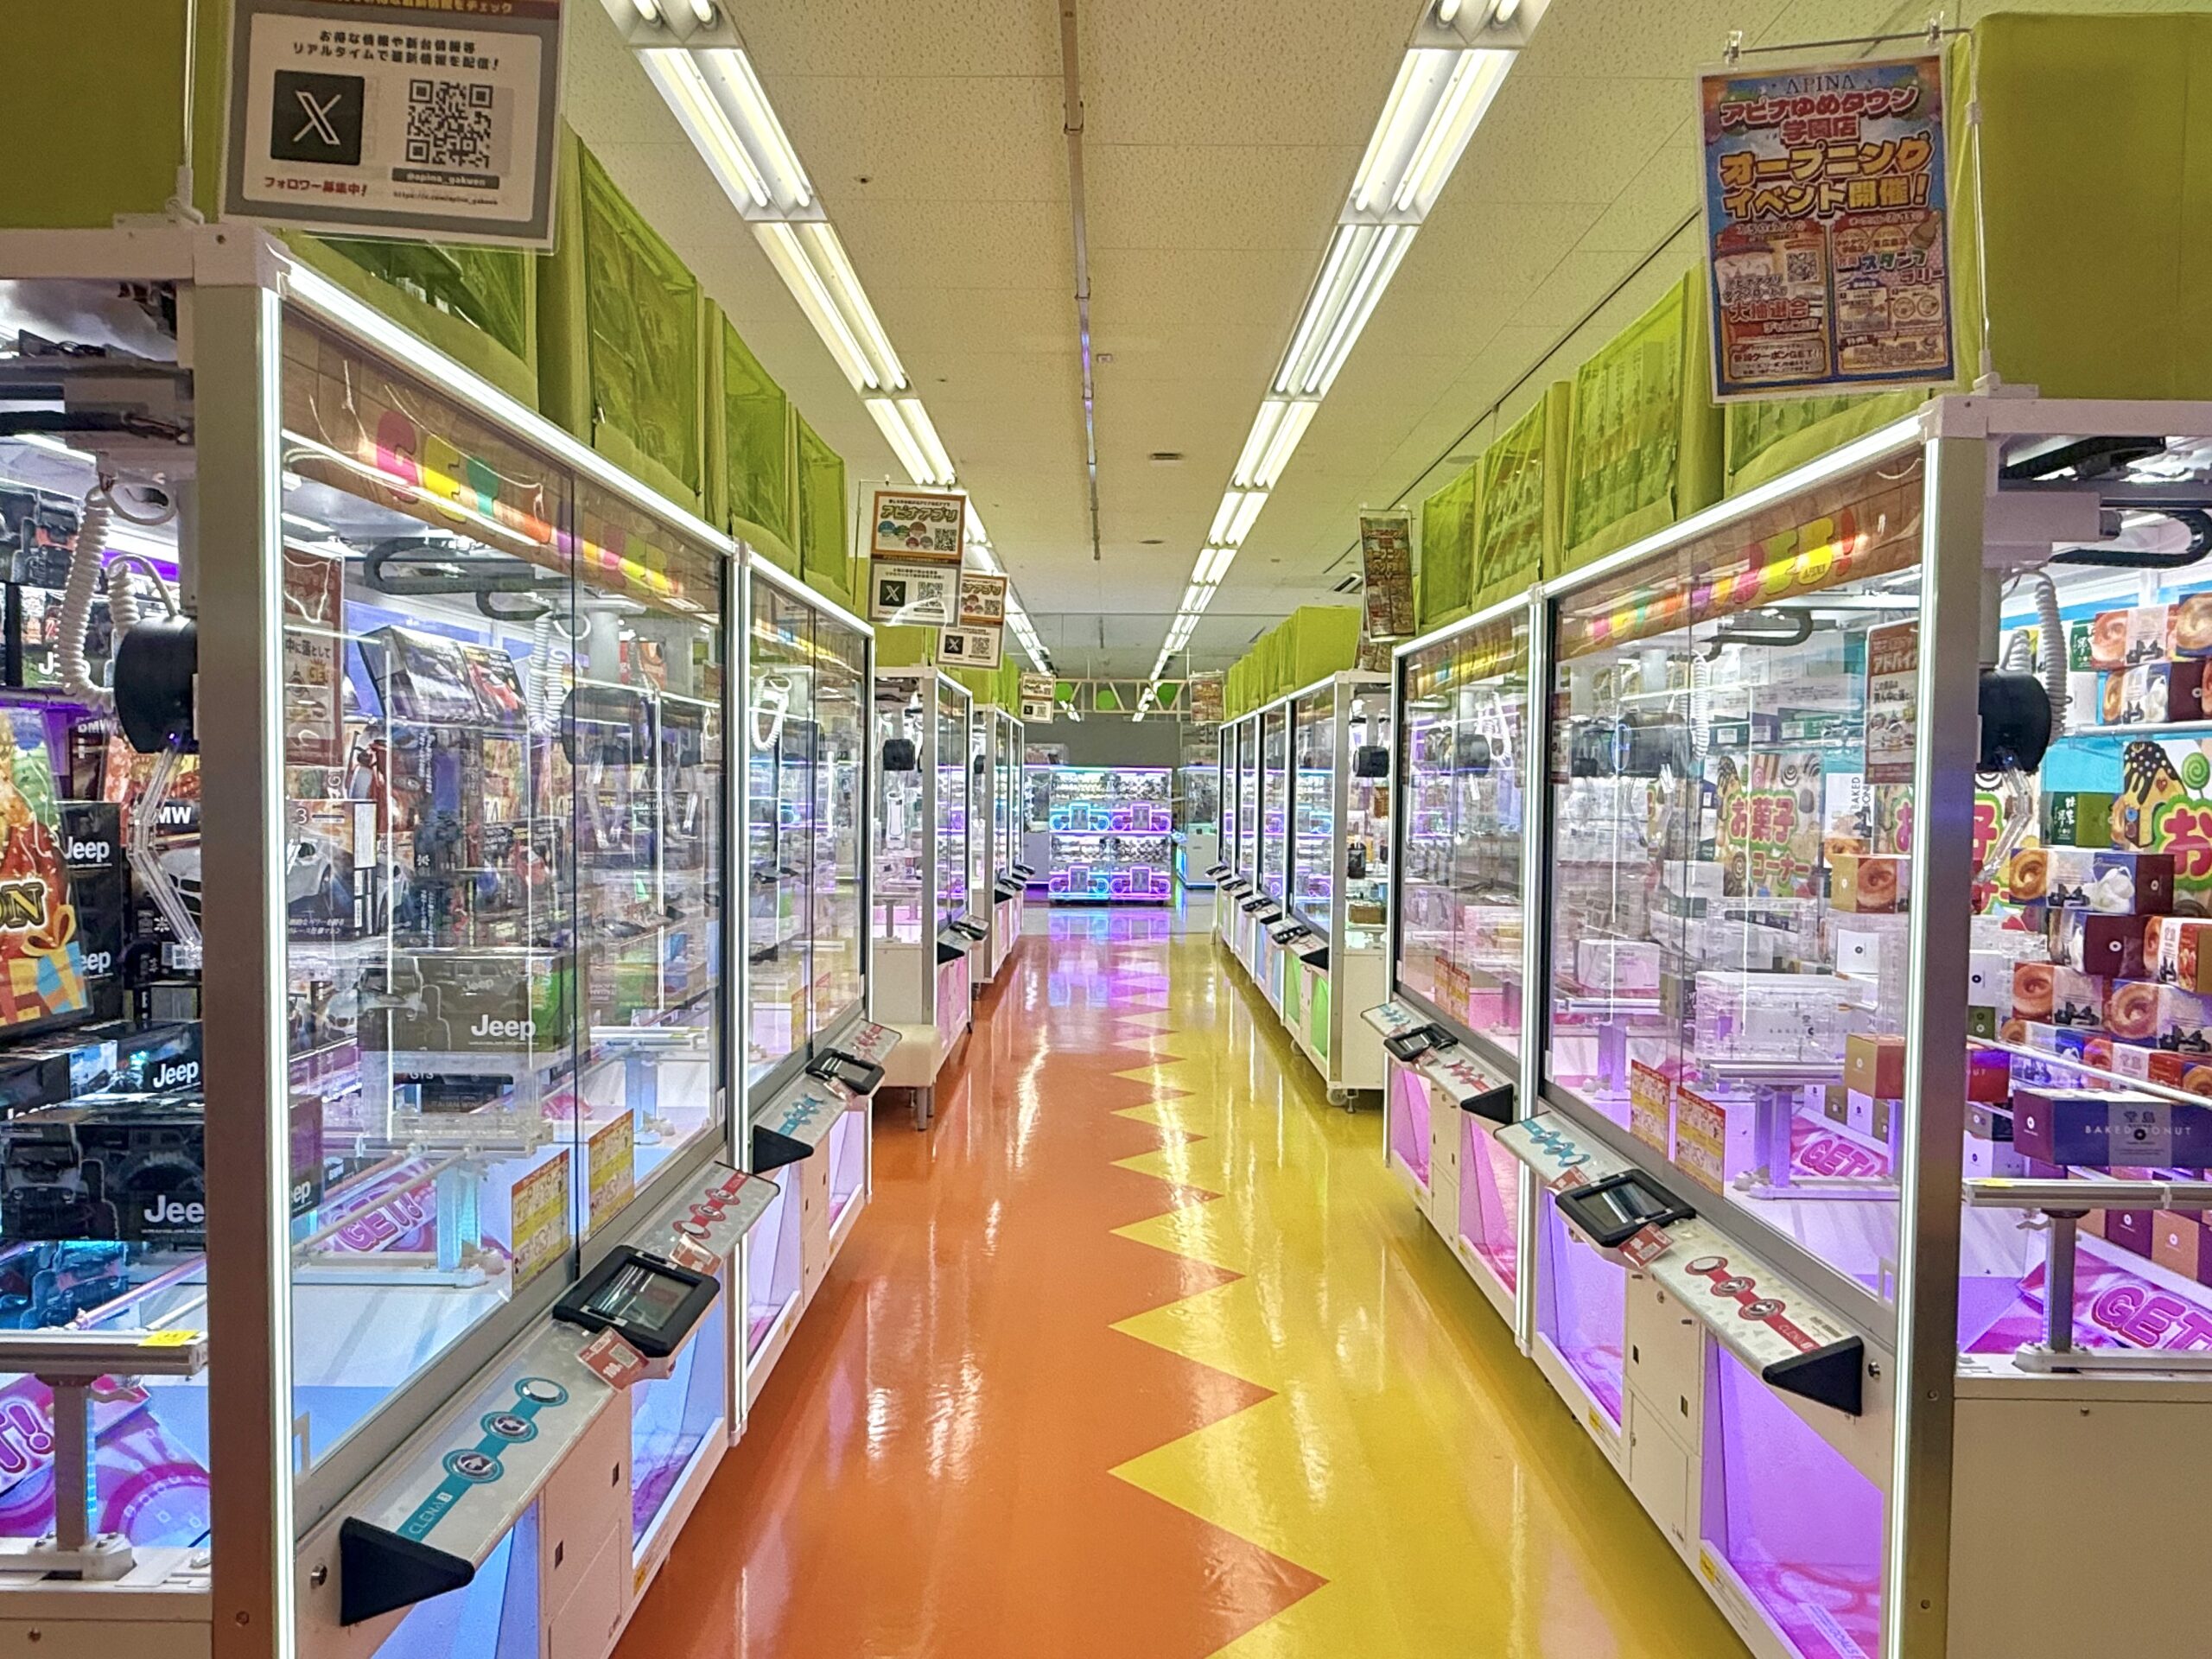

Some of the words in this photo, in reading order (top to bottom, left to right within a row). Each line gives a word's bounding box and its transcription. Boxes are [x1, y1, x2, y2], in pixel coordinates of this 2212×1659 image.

[1785, 75, 1856, 94] APINA
[1719, 86, 1920, 127] アピナゆめタウン
[1781, 116, 1861, 144] 学園店
[1719, 130, 1935, 188] オープニング
[1731, 795, 1796, 845] お菓子
[67, 836, 111, 862] Jeep
[1752, 851, 1811, 881] コーナー
[79, 950, 111, 973] eep
[471, 1014, 537, 1041] Jeep
[153, 1061, 199, 1088] Jeep
[2085, 1124, 2134, 1135] BAKED
[143, 1194, 206, 1224] Jee
